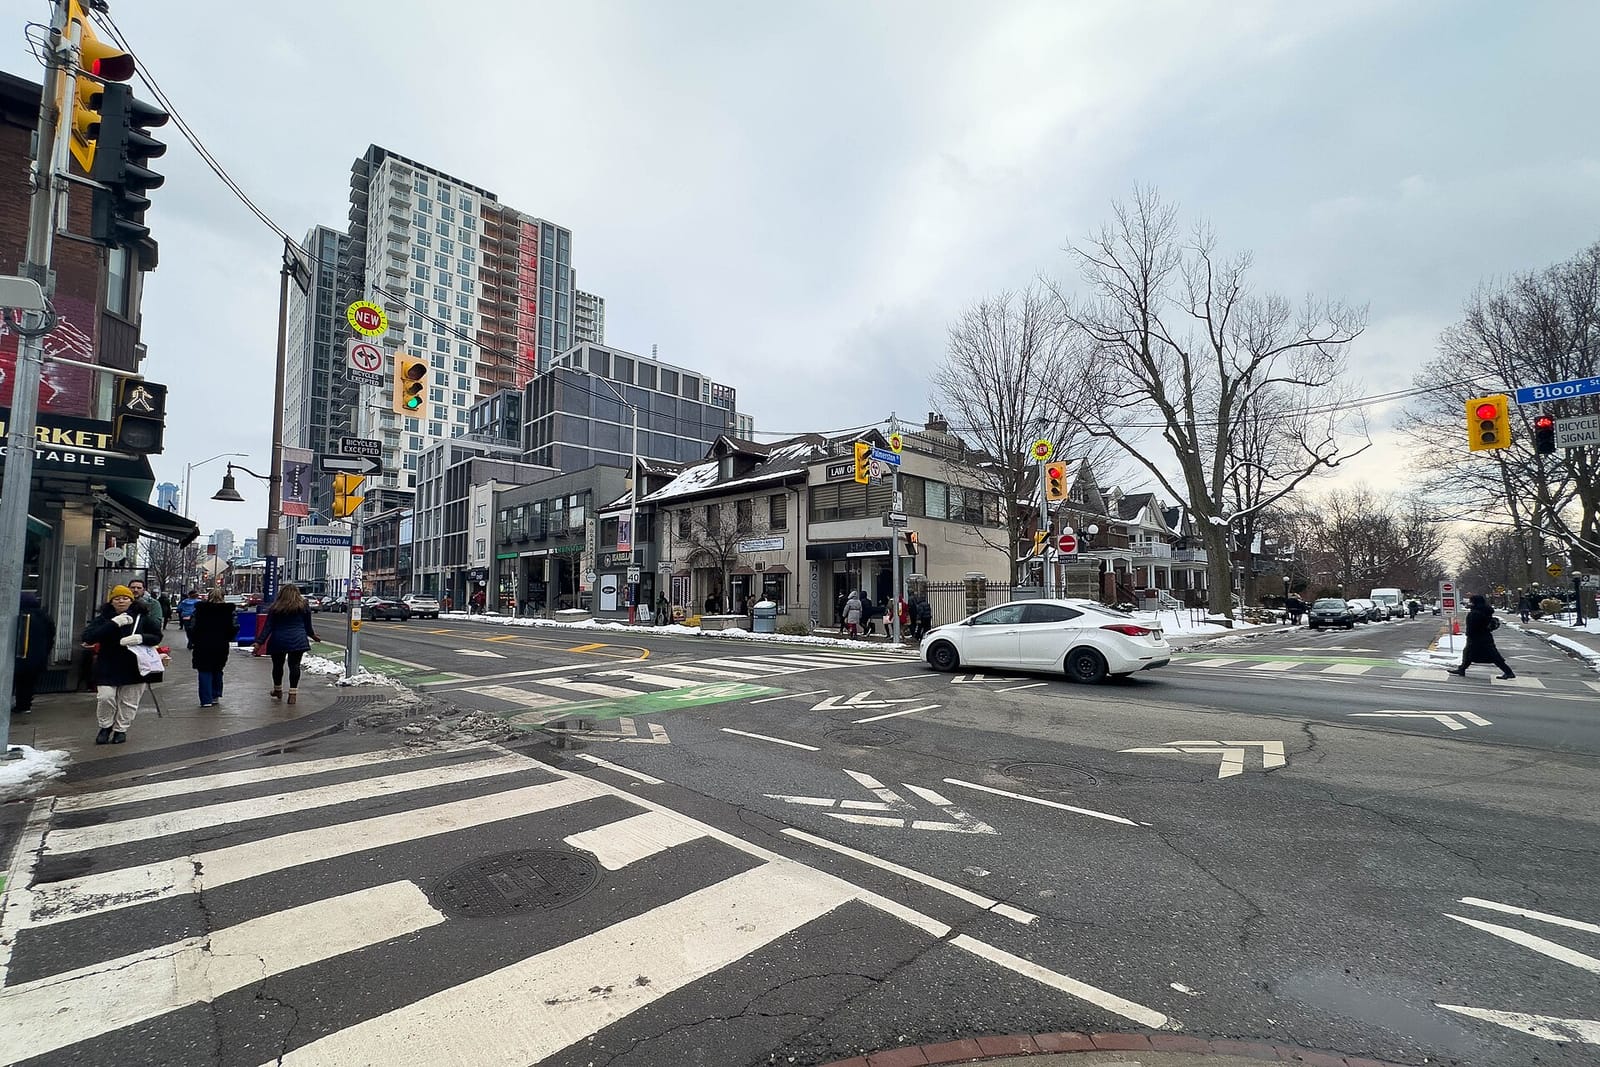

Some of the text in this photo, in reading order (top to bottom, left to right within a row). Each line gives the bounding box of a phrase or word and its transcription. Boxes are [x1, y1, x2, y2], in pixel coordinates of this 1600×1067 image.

[355, 310, 380, 326] NEW
[352, 370, 379, 380] BICYCLES
[351, 375, 380, 386] EXCEPTED
[1533, 384, 1582, 399] Bloor
[1558, 419, 1598, 432] BICYCLE
[0, 421, 113, 449] RKET
[1560, 431, 1598, 443] SIGNAL
[346, 439, 378, 448] BICYCLES
[344, 446, 380, 455] EXCEPTED
[831, 466, 845, 476] LAW
[301, 535, 341, 545] Palmerston
[628, 574, 639, 582] 40
